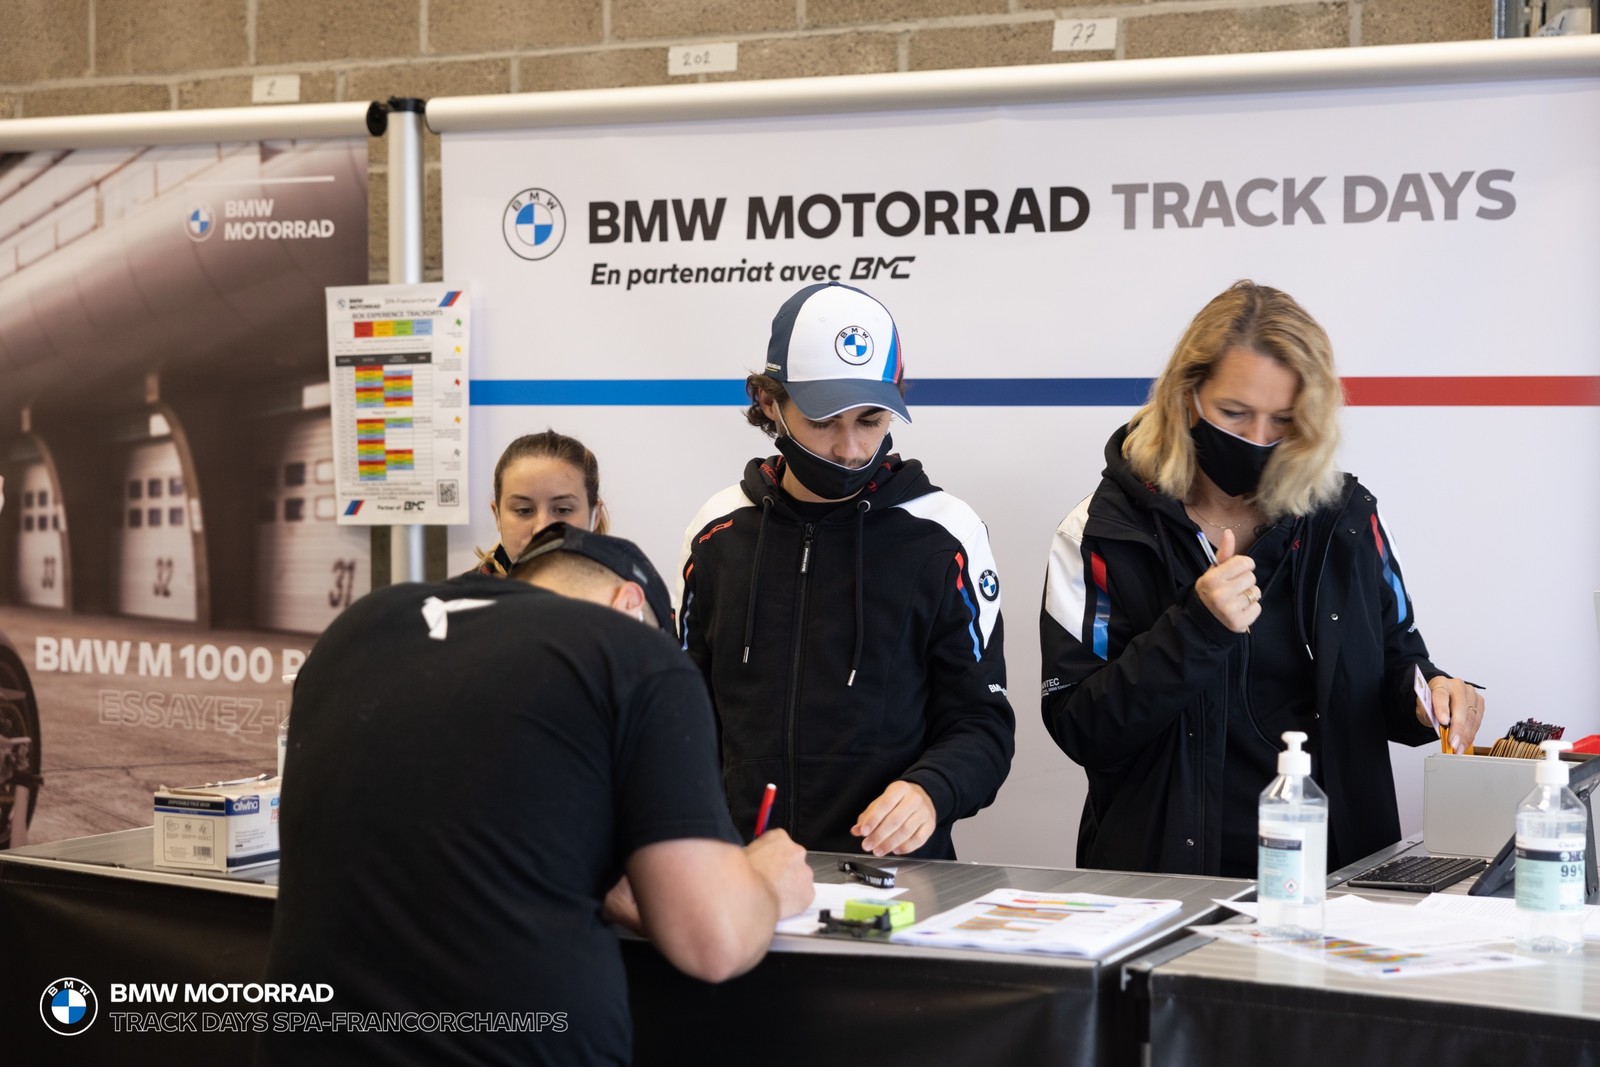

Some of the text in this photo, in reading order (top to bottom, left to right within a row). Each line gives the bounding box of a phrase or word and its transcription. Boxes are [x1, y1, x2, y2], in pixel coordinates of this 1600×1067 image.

[1070, 23, 1096, 46] 77
[682, 51, 711, 66] 202
[224, 199, 275, 218] BMW
[588, 168, 1518, 244] BMW MOTORRAD TRACK DAYS
[224, 219, 336, 241] MOTORRAD
[591, 256, 916, 291] En partenariat avec BMC
[840, 326, 870, 340] BMW
[35, 636, 131, 675] BMW
[138, 642, 173, 678] M
[180, 644, 274, 684] 1000
